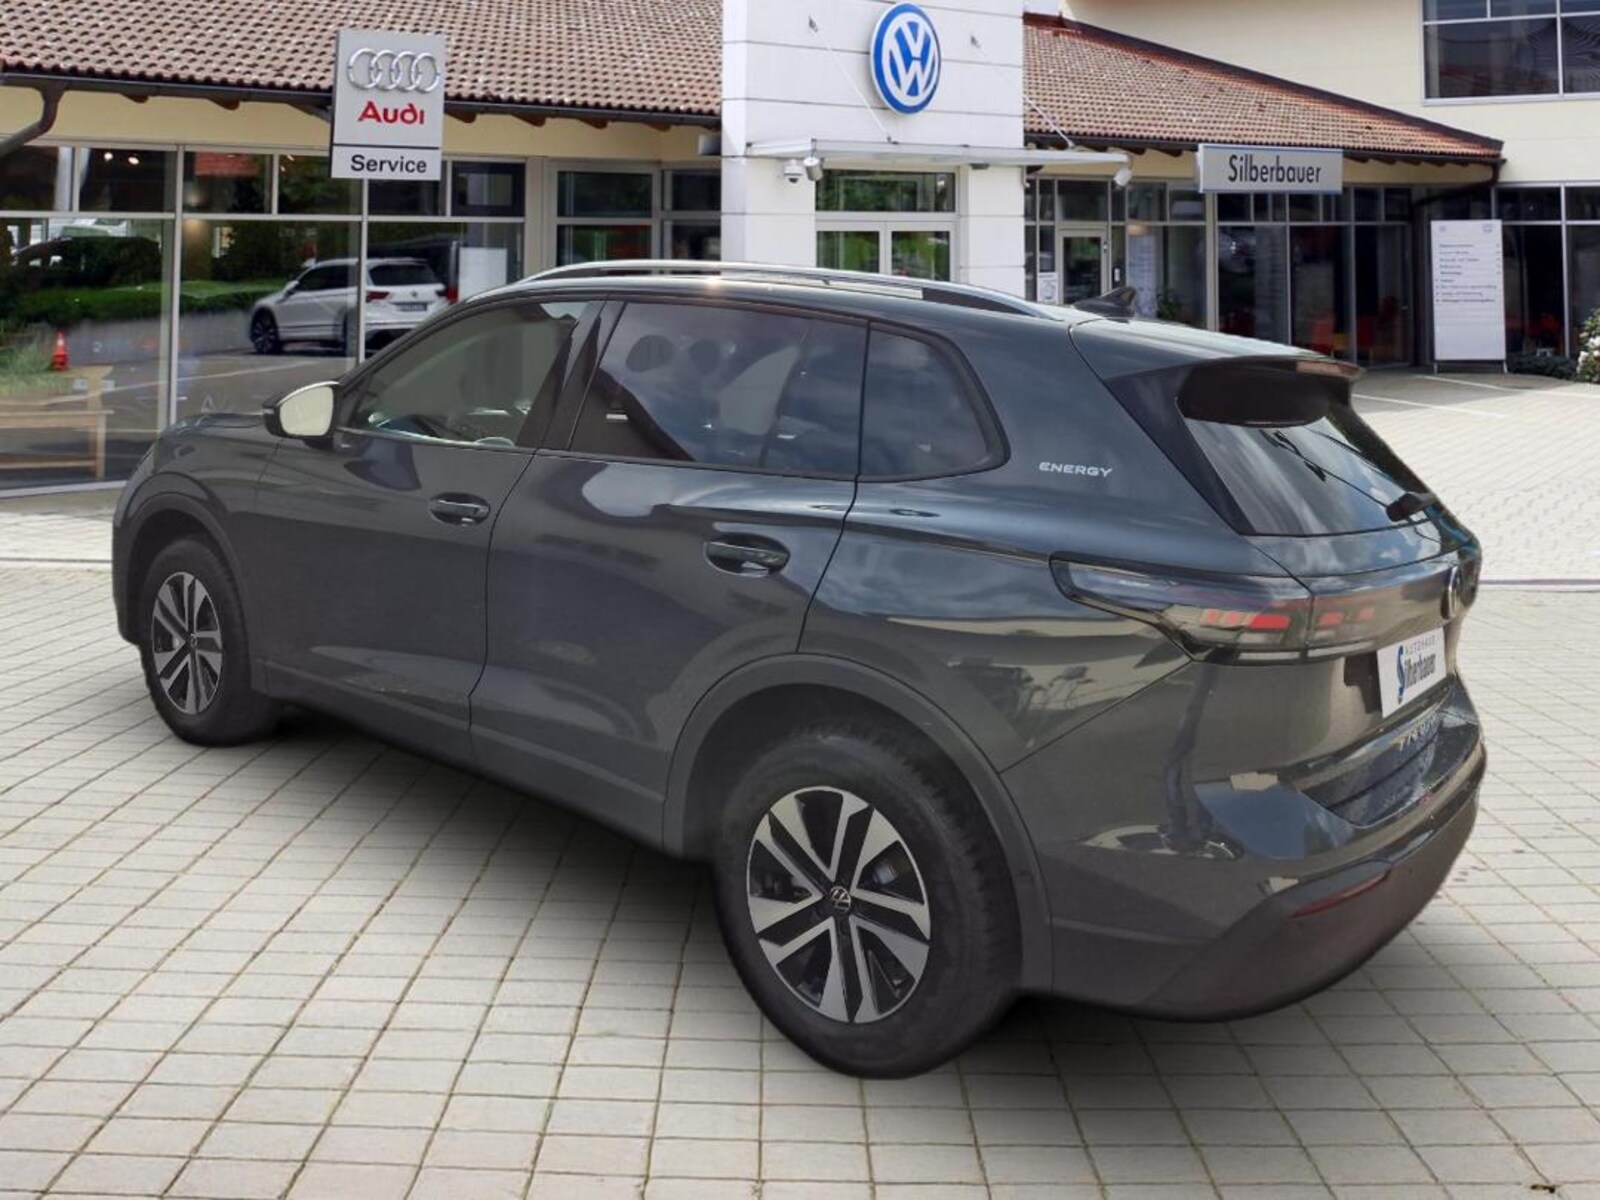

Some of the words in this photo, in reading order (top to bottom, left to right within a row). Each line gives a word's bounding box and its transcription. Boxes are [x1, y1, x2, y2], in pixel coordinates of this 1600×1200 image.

[357, 100, 425, 125] Audi
[351, 154, 427, 173] Service
[1228, 154, 1322, 183] Silberbauer
[1039, 461, 1113, 478] ENERGY
